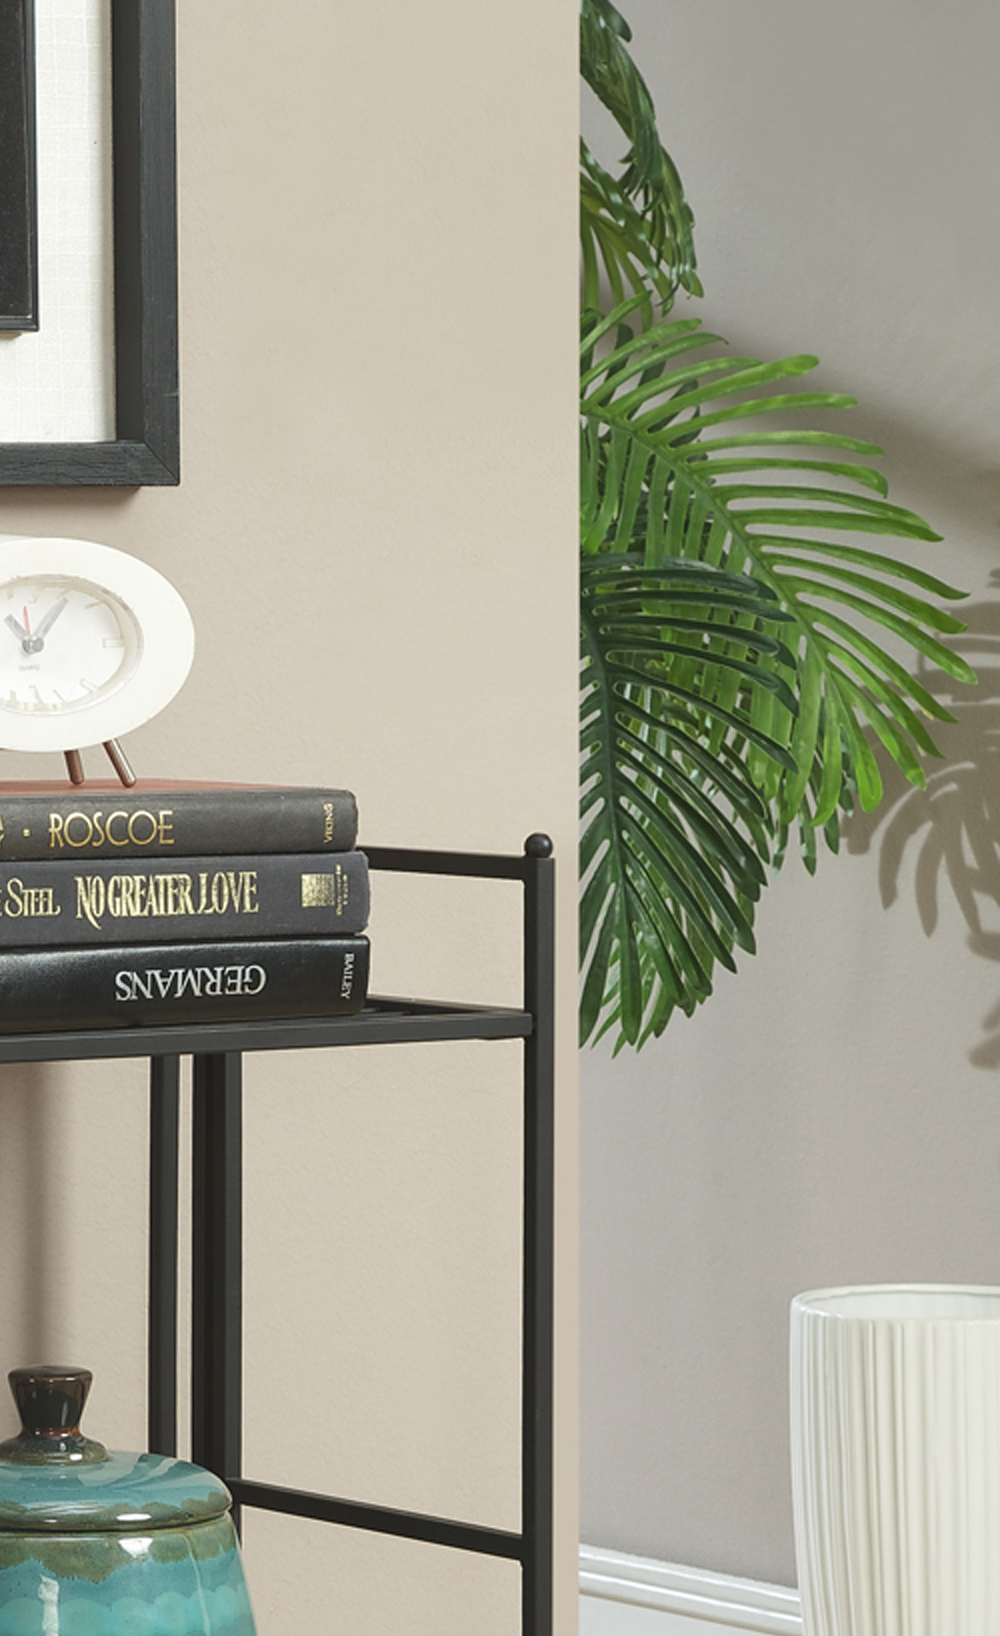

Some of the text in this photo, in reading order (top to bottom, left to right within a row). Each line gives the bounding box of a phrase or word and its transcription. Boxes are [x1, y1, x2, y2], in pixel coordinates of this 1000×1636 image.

[48, 810, 175, 848] ROSCOE
[322, 803, 334, 843] VIKING
[74, 871, 260, 930] NO GREATER LOVE
[115, 964, 267, 1001] GERMANS
[340, 952, 355, 999] BAILEY
